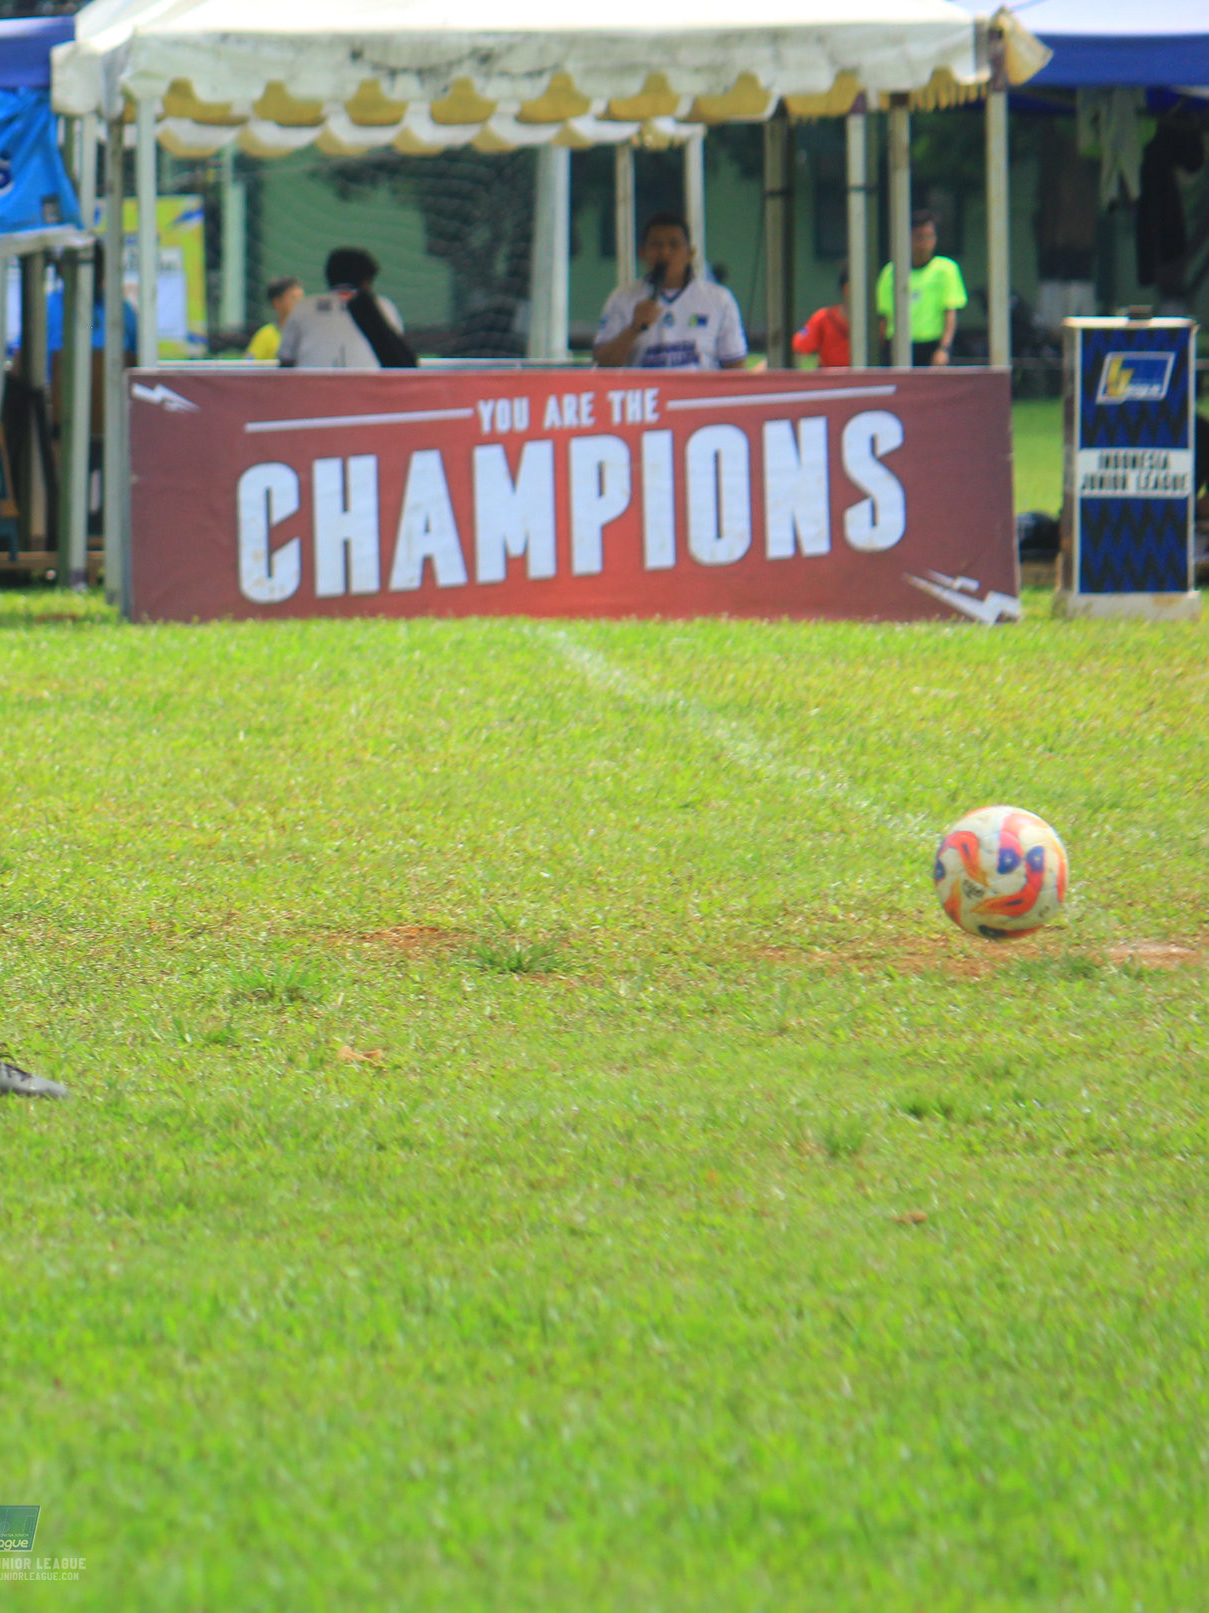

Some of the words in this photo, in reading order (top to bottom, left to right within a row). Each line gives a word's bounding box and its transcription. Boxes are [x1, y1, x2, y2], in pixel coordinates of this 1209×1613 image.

[478, 397, 530, 435] YOU
[544, 391, 596, 430] ARE
[608, 387, 661, 426] THE
[237, 409, 907, 604] CHAMPIONS
